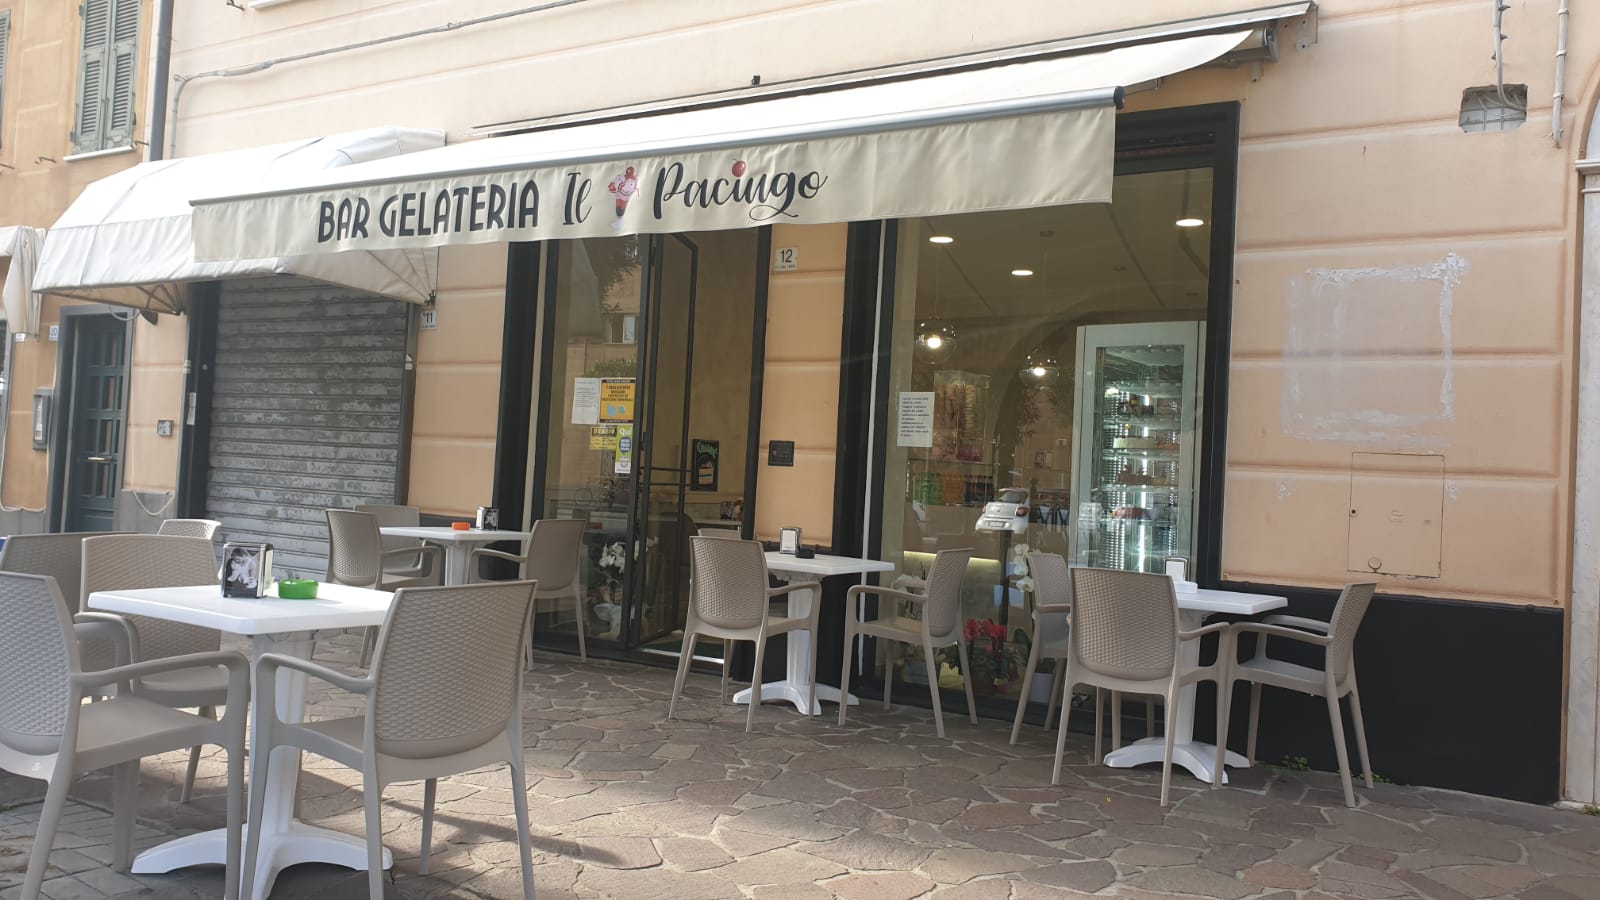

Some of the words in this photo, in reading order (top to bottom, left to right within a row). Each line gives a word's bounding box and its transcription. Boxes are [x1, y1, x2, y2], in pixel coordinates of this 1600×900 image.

[318, 197, 370, 243] BAR
[379, 179, 540, 238] GELATERIA
[562, 172, 593, 225] Il
[653, 159, 828, 221] Paciugo
[780, 248, 793, 263] 12
[425, 311, 433, 324] 11
